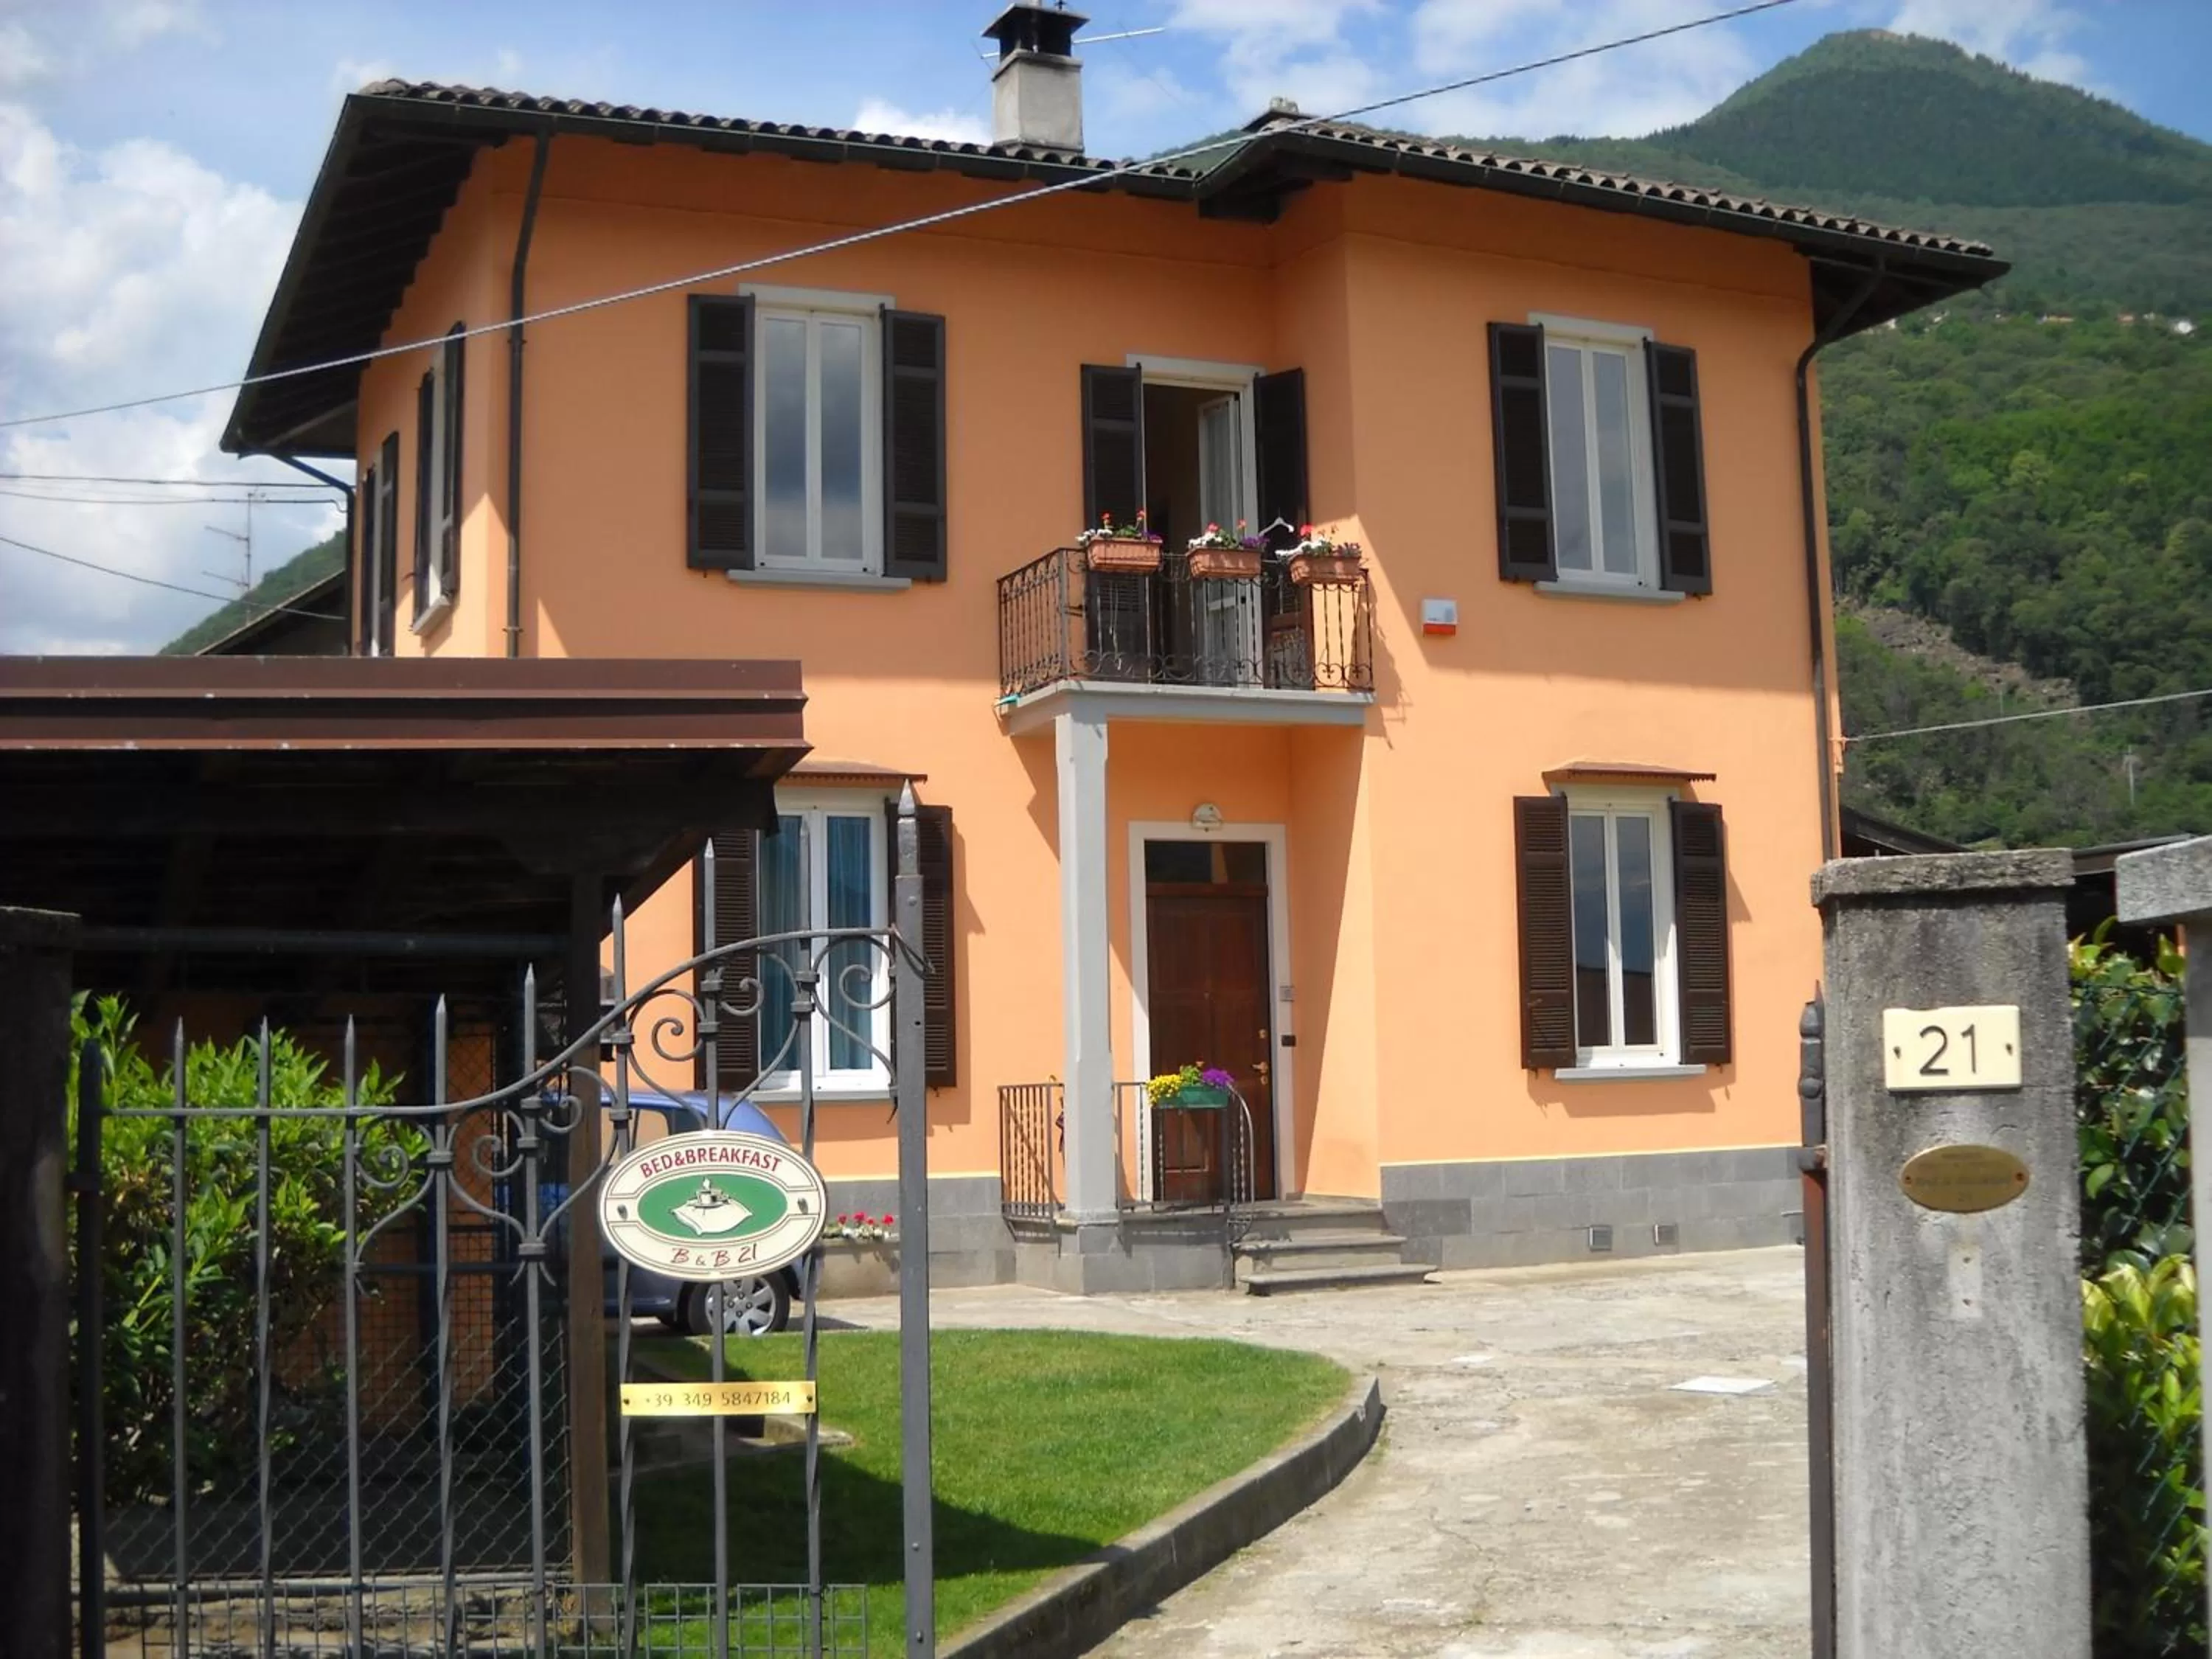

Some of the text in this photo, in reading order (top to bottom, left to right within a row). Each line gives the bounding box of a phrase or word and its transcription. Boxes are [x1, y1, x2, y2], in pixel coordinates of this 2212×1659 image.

[1919, 1024, 1977, 1075] 21
[640, 1147, 782, 1178] BED&BREAKFAST
[738, 1244, 757, 1262] 21
[684, 1393, 712, 1408] 349
[721, 1391, 790, 1407] 5847184
